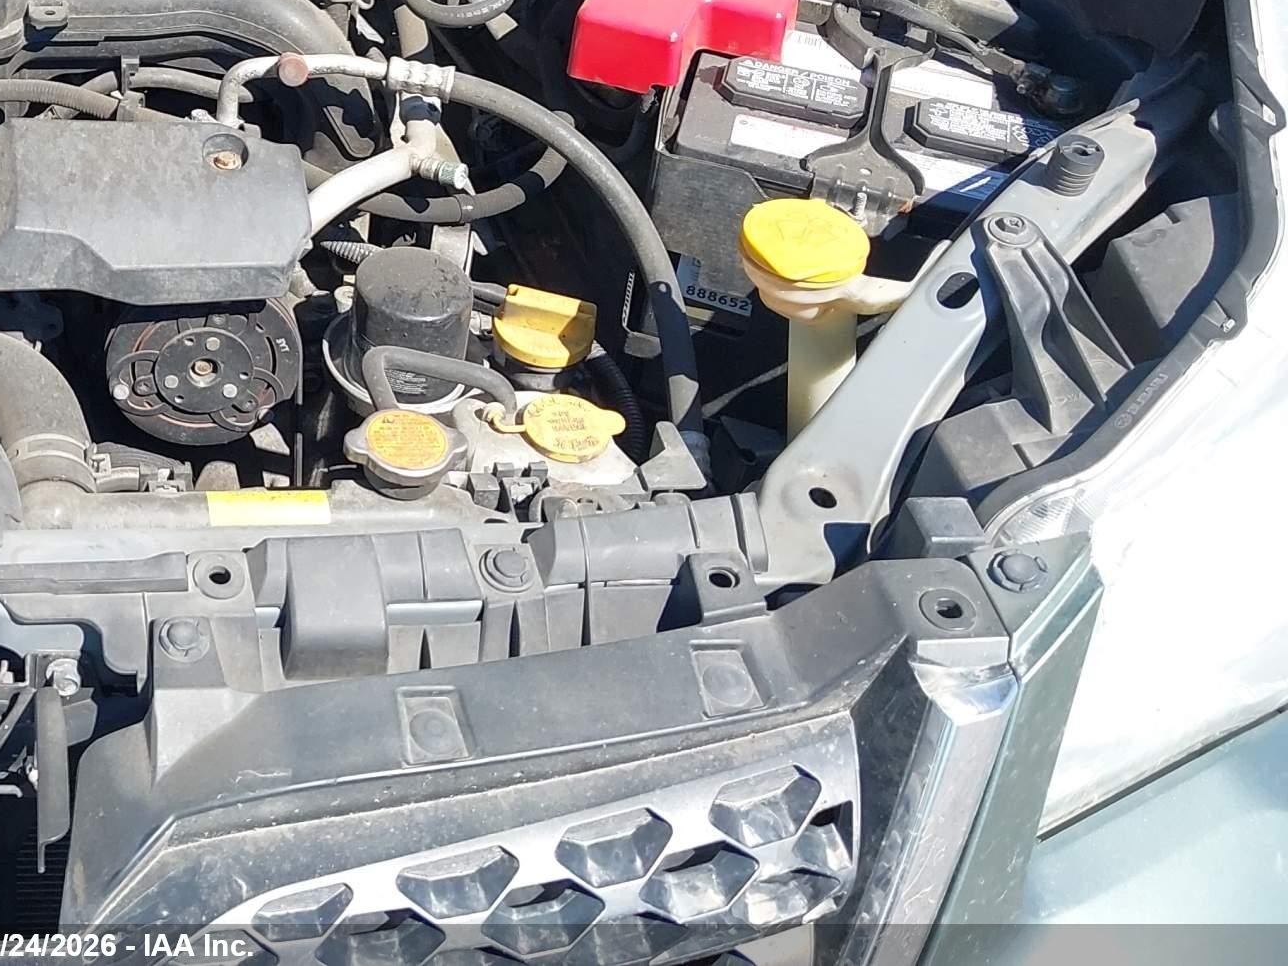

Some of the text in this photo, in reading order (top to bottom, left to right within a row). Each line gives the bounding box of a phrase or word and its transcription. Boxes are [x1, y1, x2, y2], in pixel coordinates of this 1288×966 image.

[753, 61, 799, 76] DANGER
[810, 72, 850, 87] POISON
[686, 285, 749, 311] 888652
